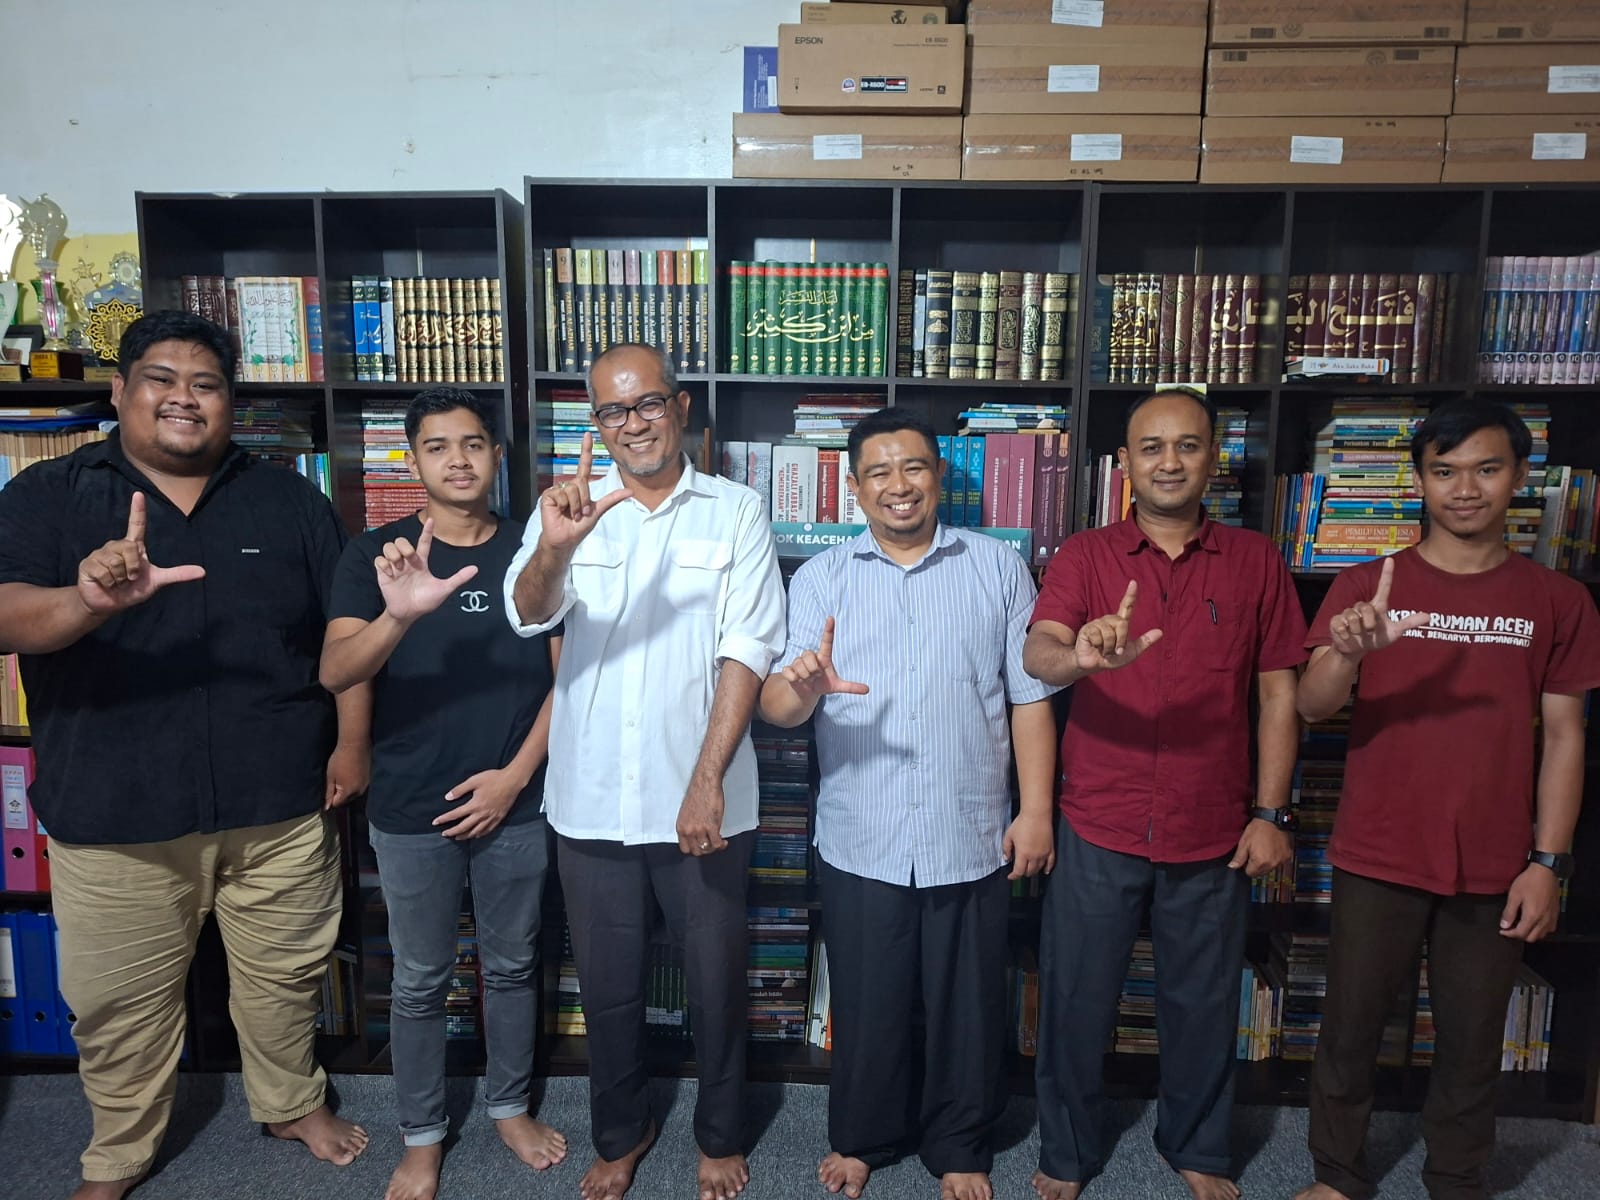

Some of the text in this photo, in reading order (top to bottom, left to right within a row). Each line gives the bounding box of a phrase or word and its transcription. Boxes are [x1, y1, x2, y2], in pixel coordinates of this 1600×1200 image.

[794, 36, 823, 45] EPSON
[791, 463, 799, 490] GHAZALI
[1345, 528, 1414, 536] PEMILU INDESIA
[774, 534, 794, 544] OK
[796, 534, 857, 544] KEACEHA
[1429, 613, 1488, 631] RUMAN
[1493, 616, 1534, 635] ACEH
[1427, 631, 1472, 643] BERKARYA,
